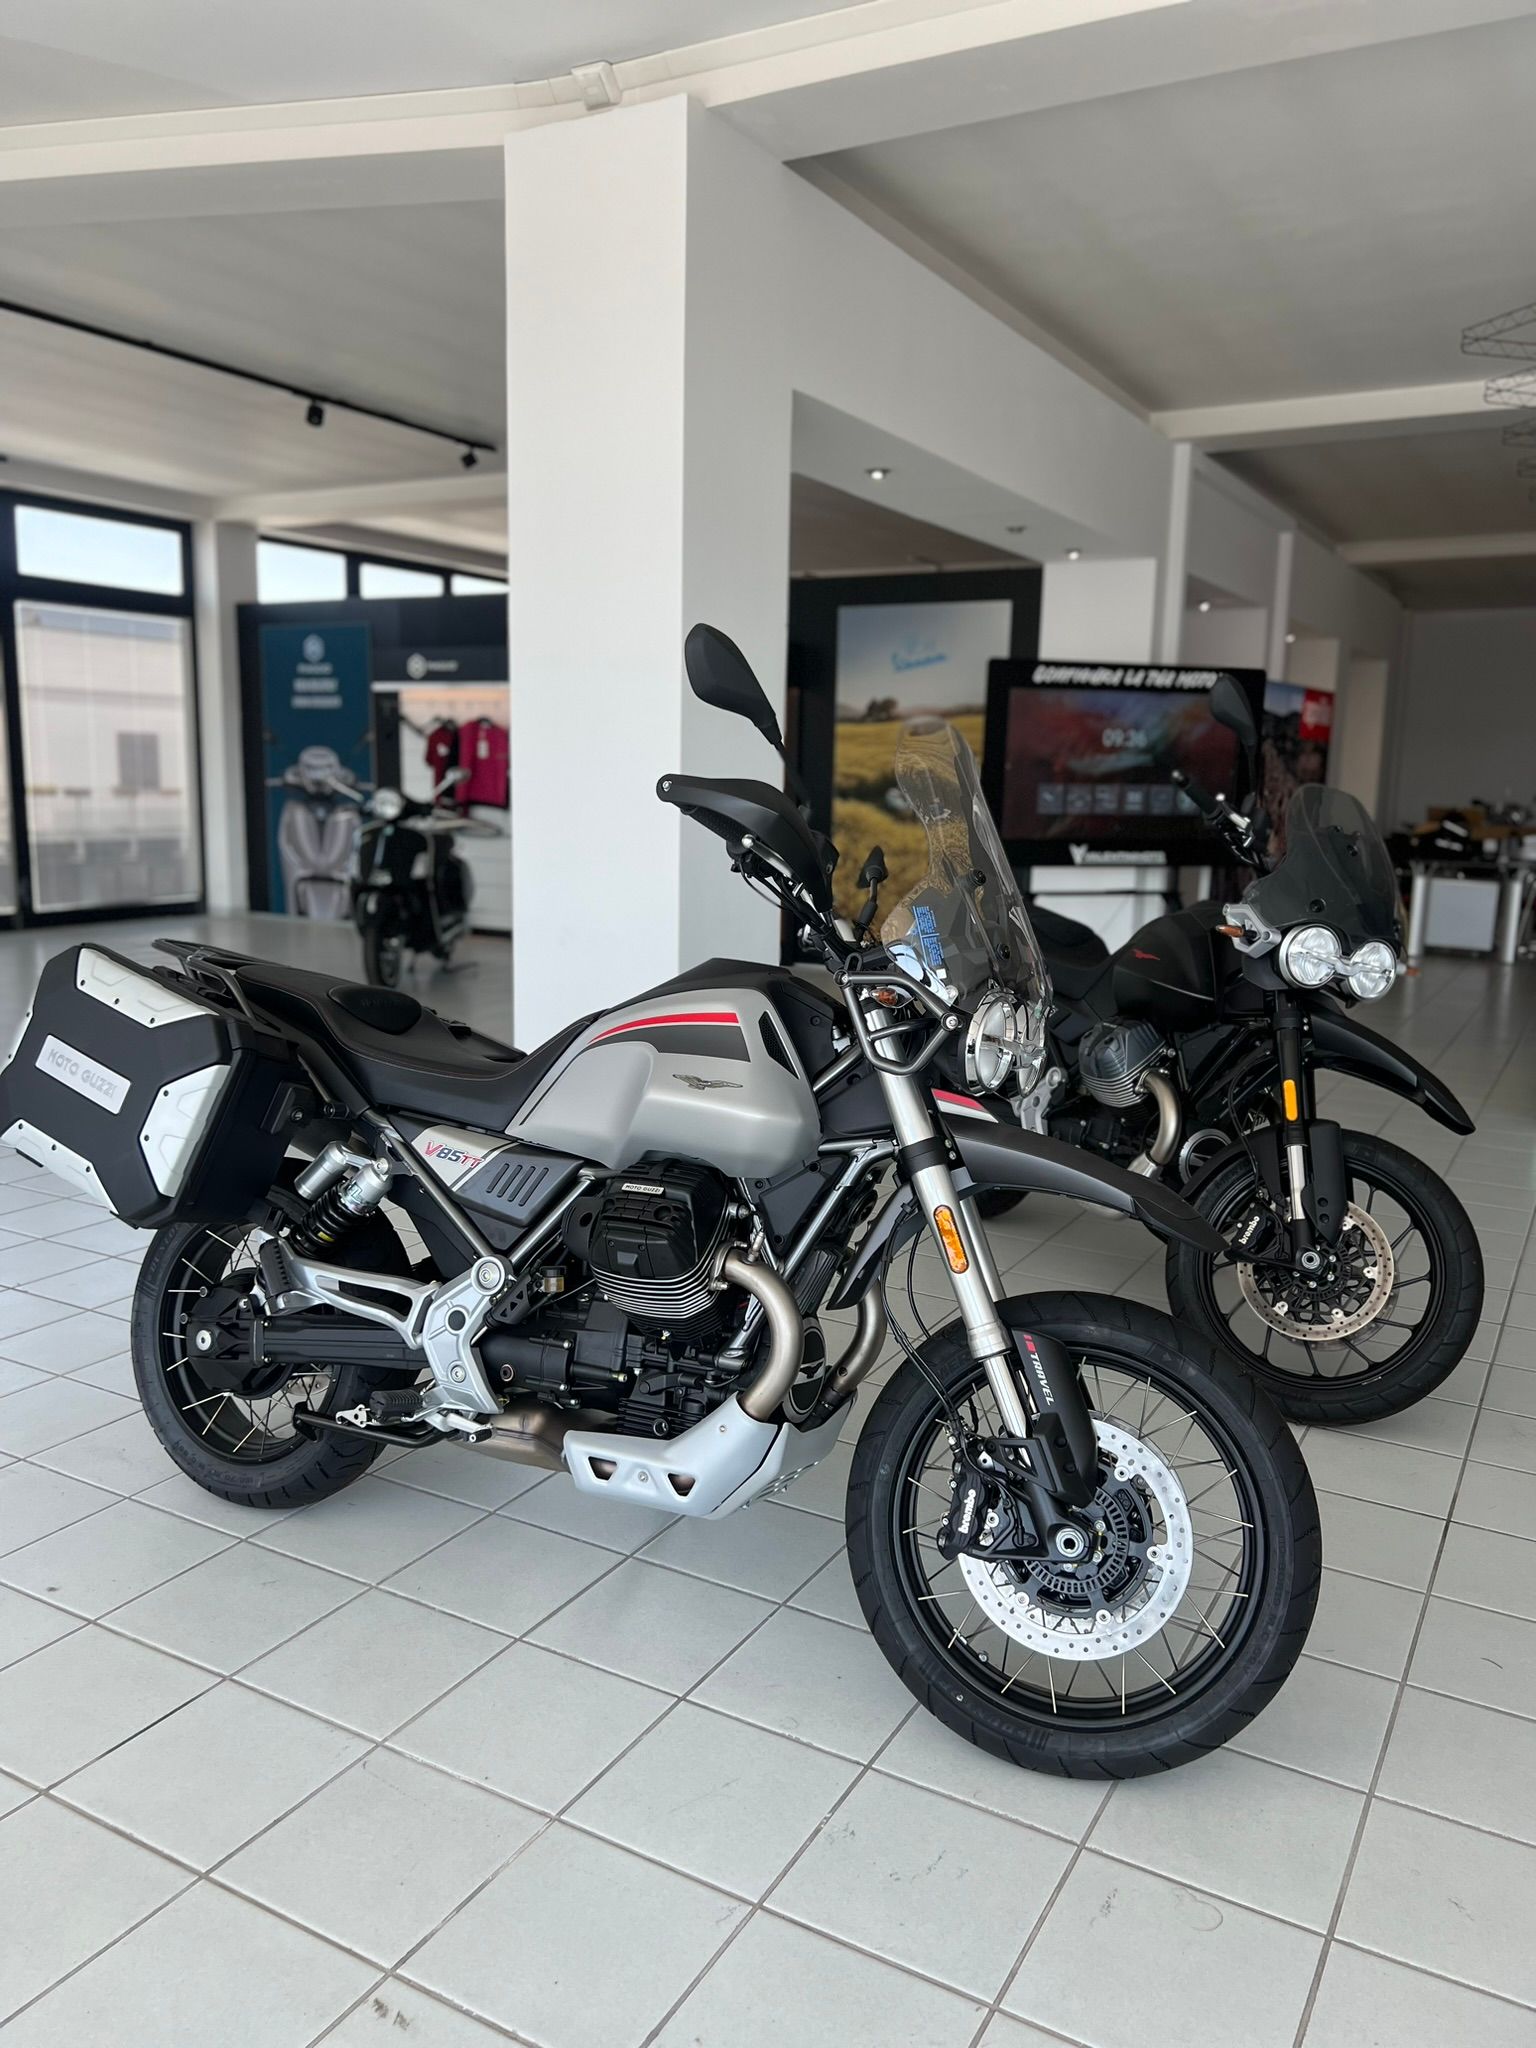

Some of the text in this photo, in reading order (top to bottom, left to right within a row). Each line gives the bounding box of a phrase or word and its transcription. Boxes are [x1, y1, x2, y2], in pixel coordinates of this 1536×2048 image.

[47, 1048, 118, 1099] MOTO GUZZI
[1238, 1215, 1260, 1245] brembo
[1030, 1352, 1055, 1406] TRAVEL
[957, 1488, 977, 1534] brembo
